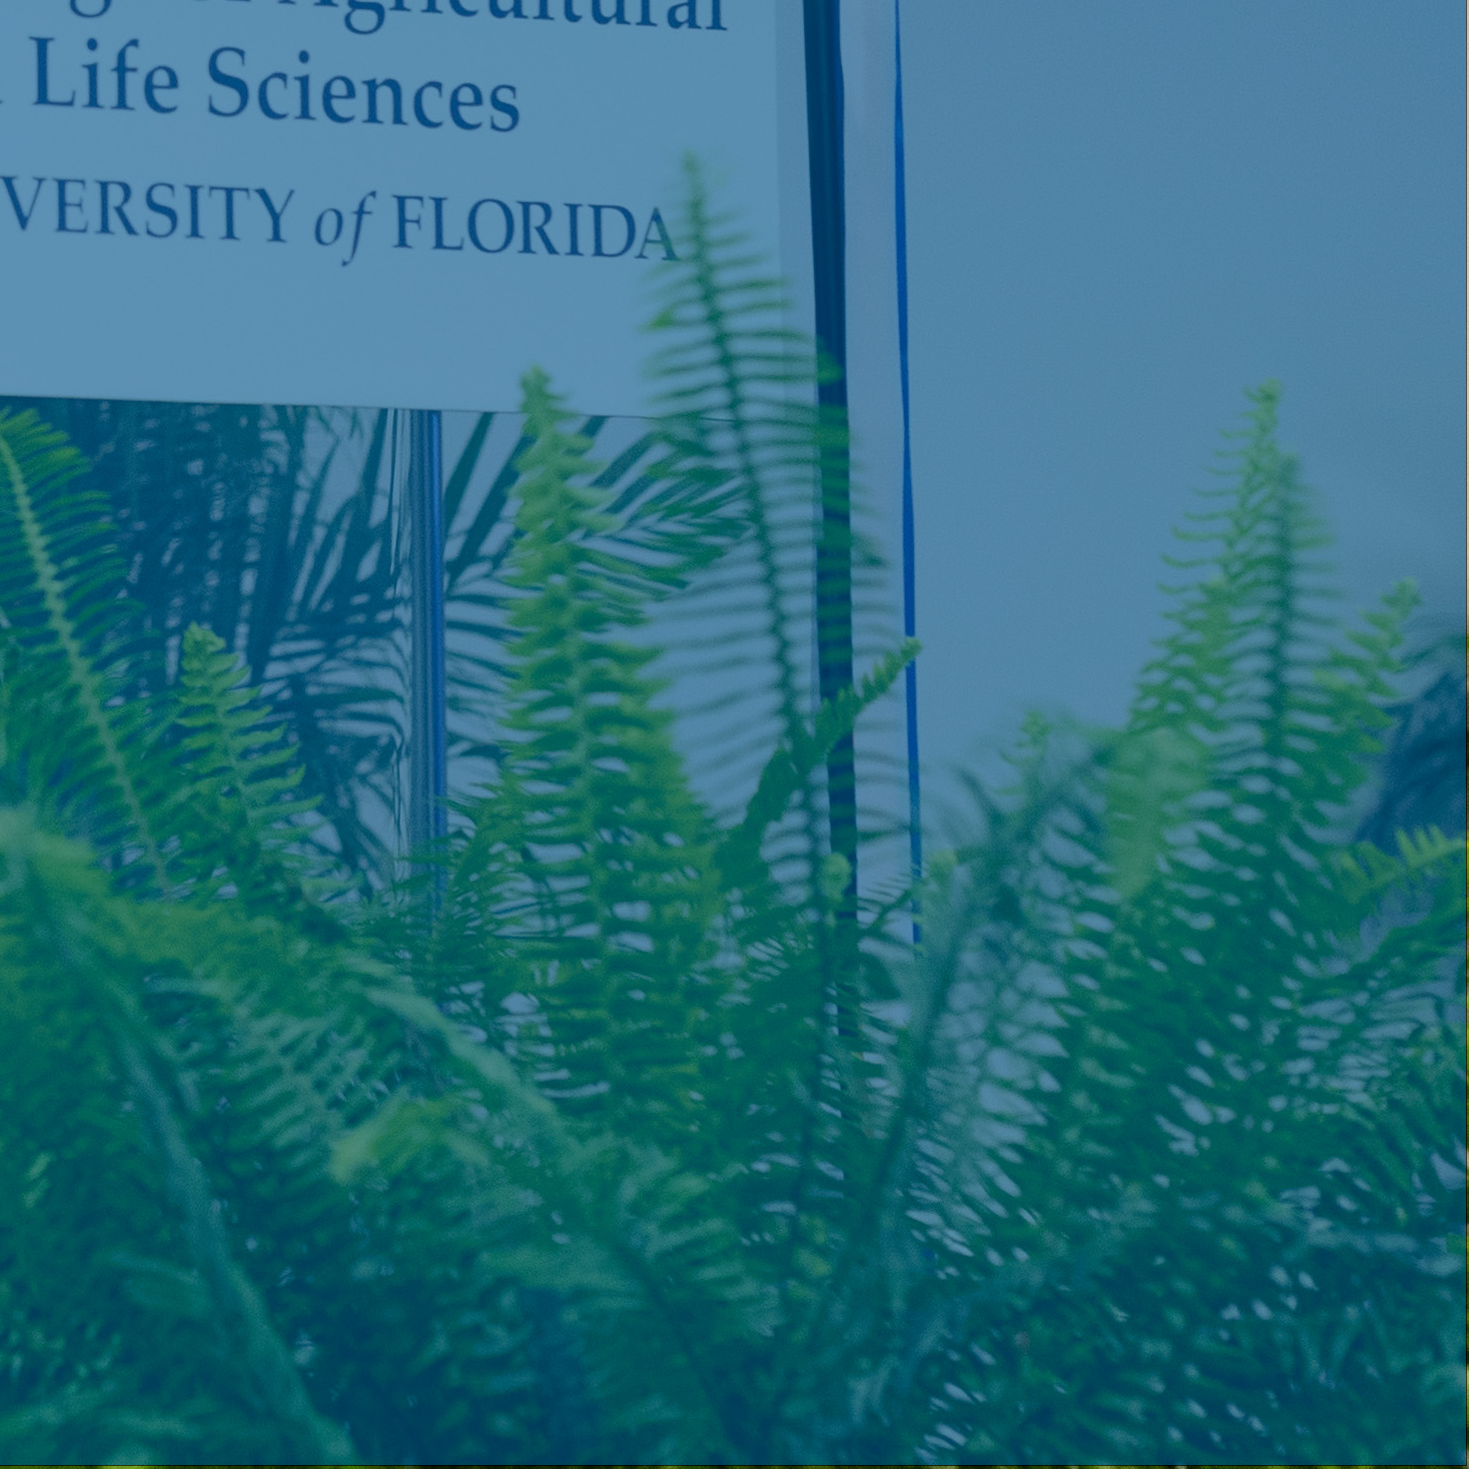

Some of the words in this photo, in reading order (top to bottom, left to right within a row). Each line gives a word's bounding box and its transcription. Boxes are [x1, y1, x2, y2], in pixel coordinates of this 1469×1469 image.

[29, 36, 179, 115] Life
[207, 46, 521, 133] Sciences
[313, 190, 377, 267] of
[391, 194, 681, 262] FLORIDA
